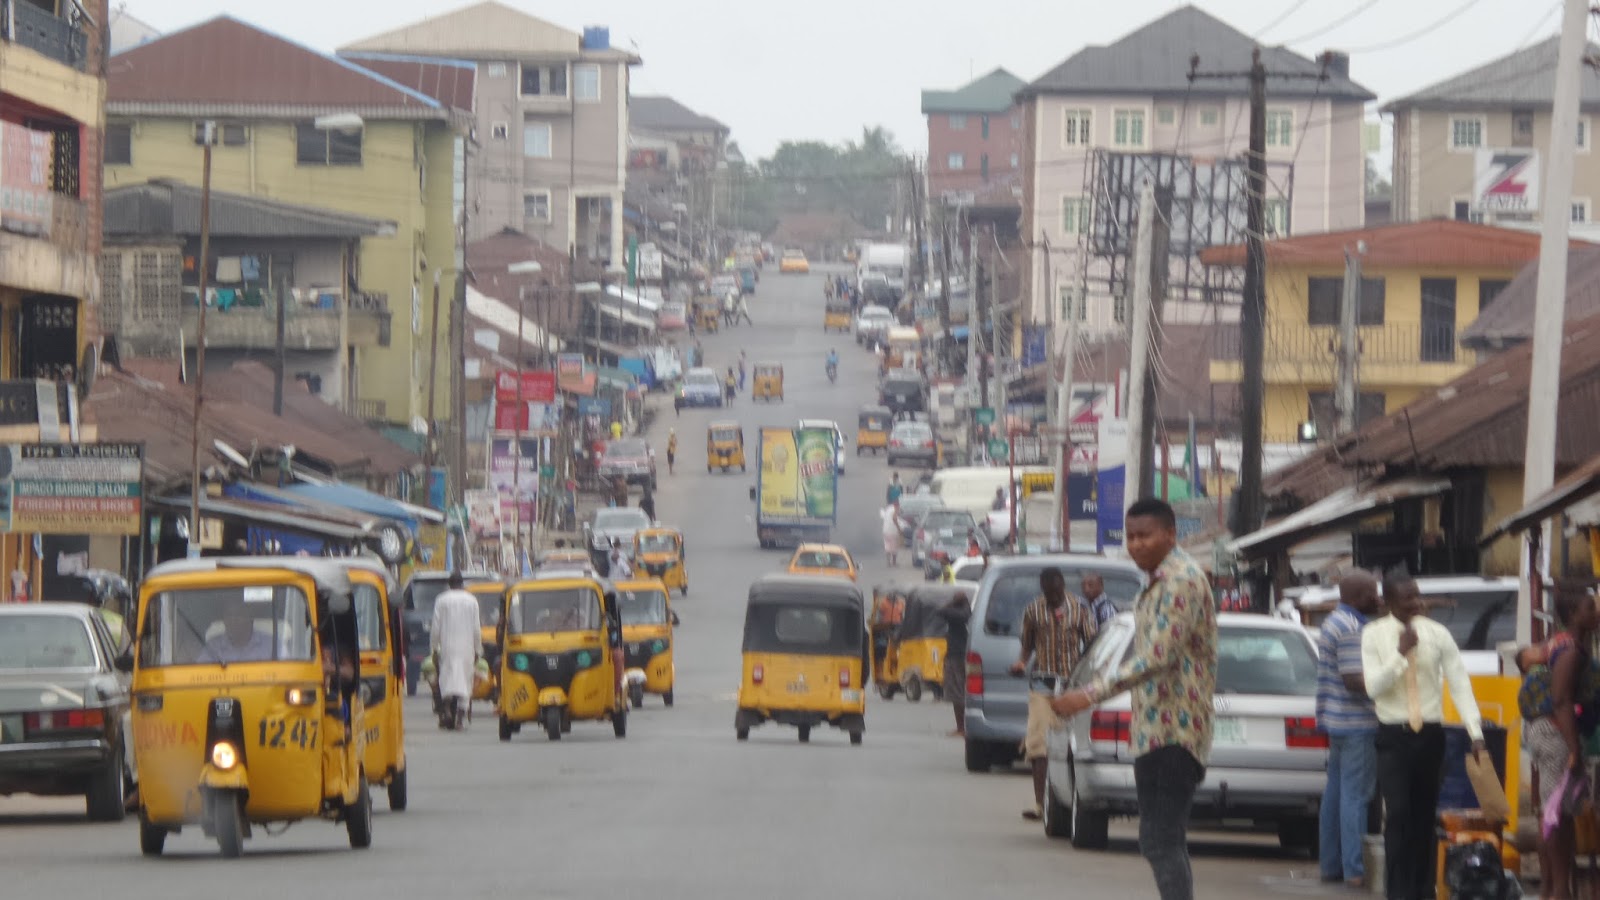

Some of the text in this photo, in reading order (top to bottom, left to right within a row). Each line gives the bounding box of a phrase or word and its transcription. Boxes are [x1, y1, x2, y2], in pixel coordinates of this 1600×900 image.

[55, 482, 96, 496] BARBING
[97, 482, 128, 496] SALON
[18, 498, 134, 511] FOREIGN STOCK SHOES
[259, 716, 318, 749] 1247
